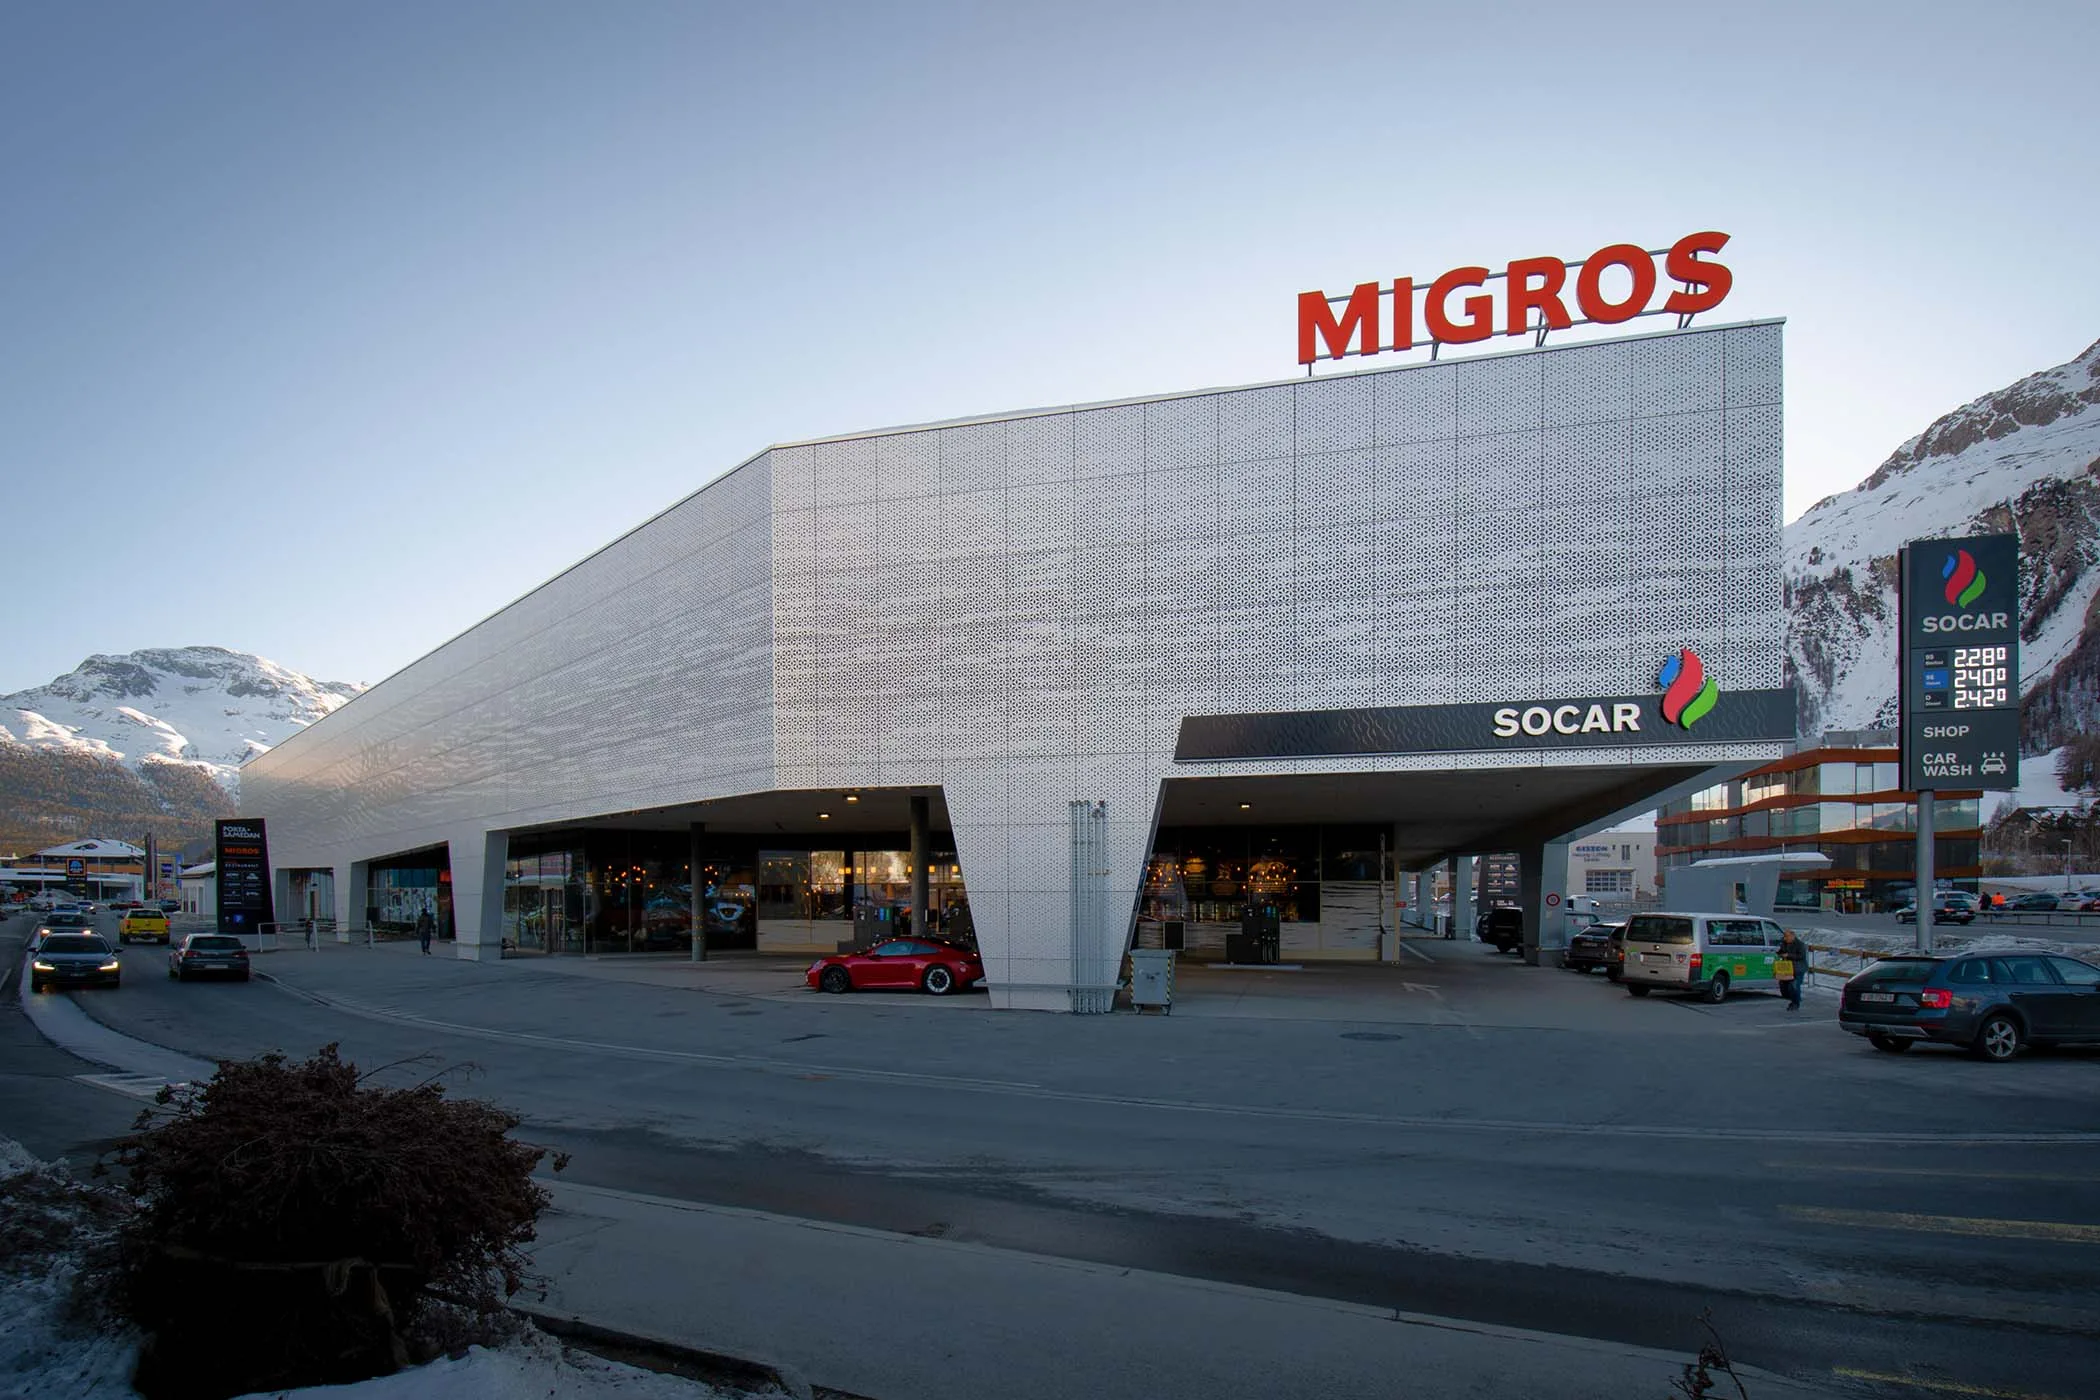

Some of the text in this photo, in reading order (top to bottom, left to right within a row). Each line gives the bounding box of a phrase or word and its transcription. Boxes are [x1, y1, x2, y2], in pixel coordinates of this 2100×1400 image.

[1298, 231, 1733, 365] MIGROS
[1922, 612, 2008, 633] SOCAR
[1493, 703, 1641, 738] SOCAR
[1923, 725, 1970, 738] SHOP
[1923, 752, 1957, 765] CAR
[1923, 764, 1972, 777] WASH
[224, 847, 259, 855] MIGROS
